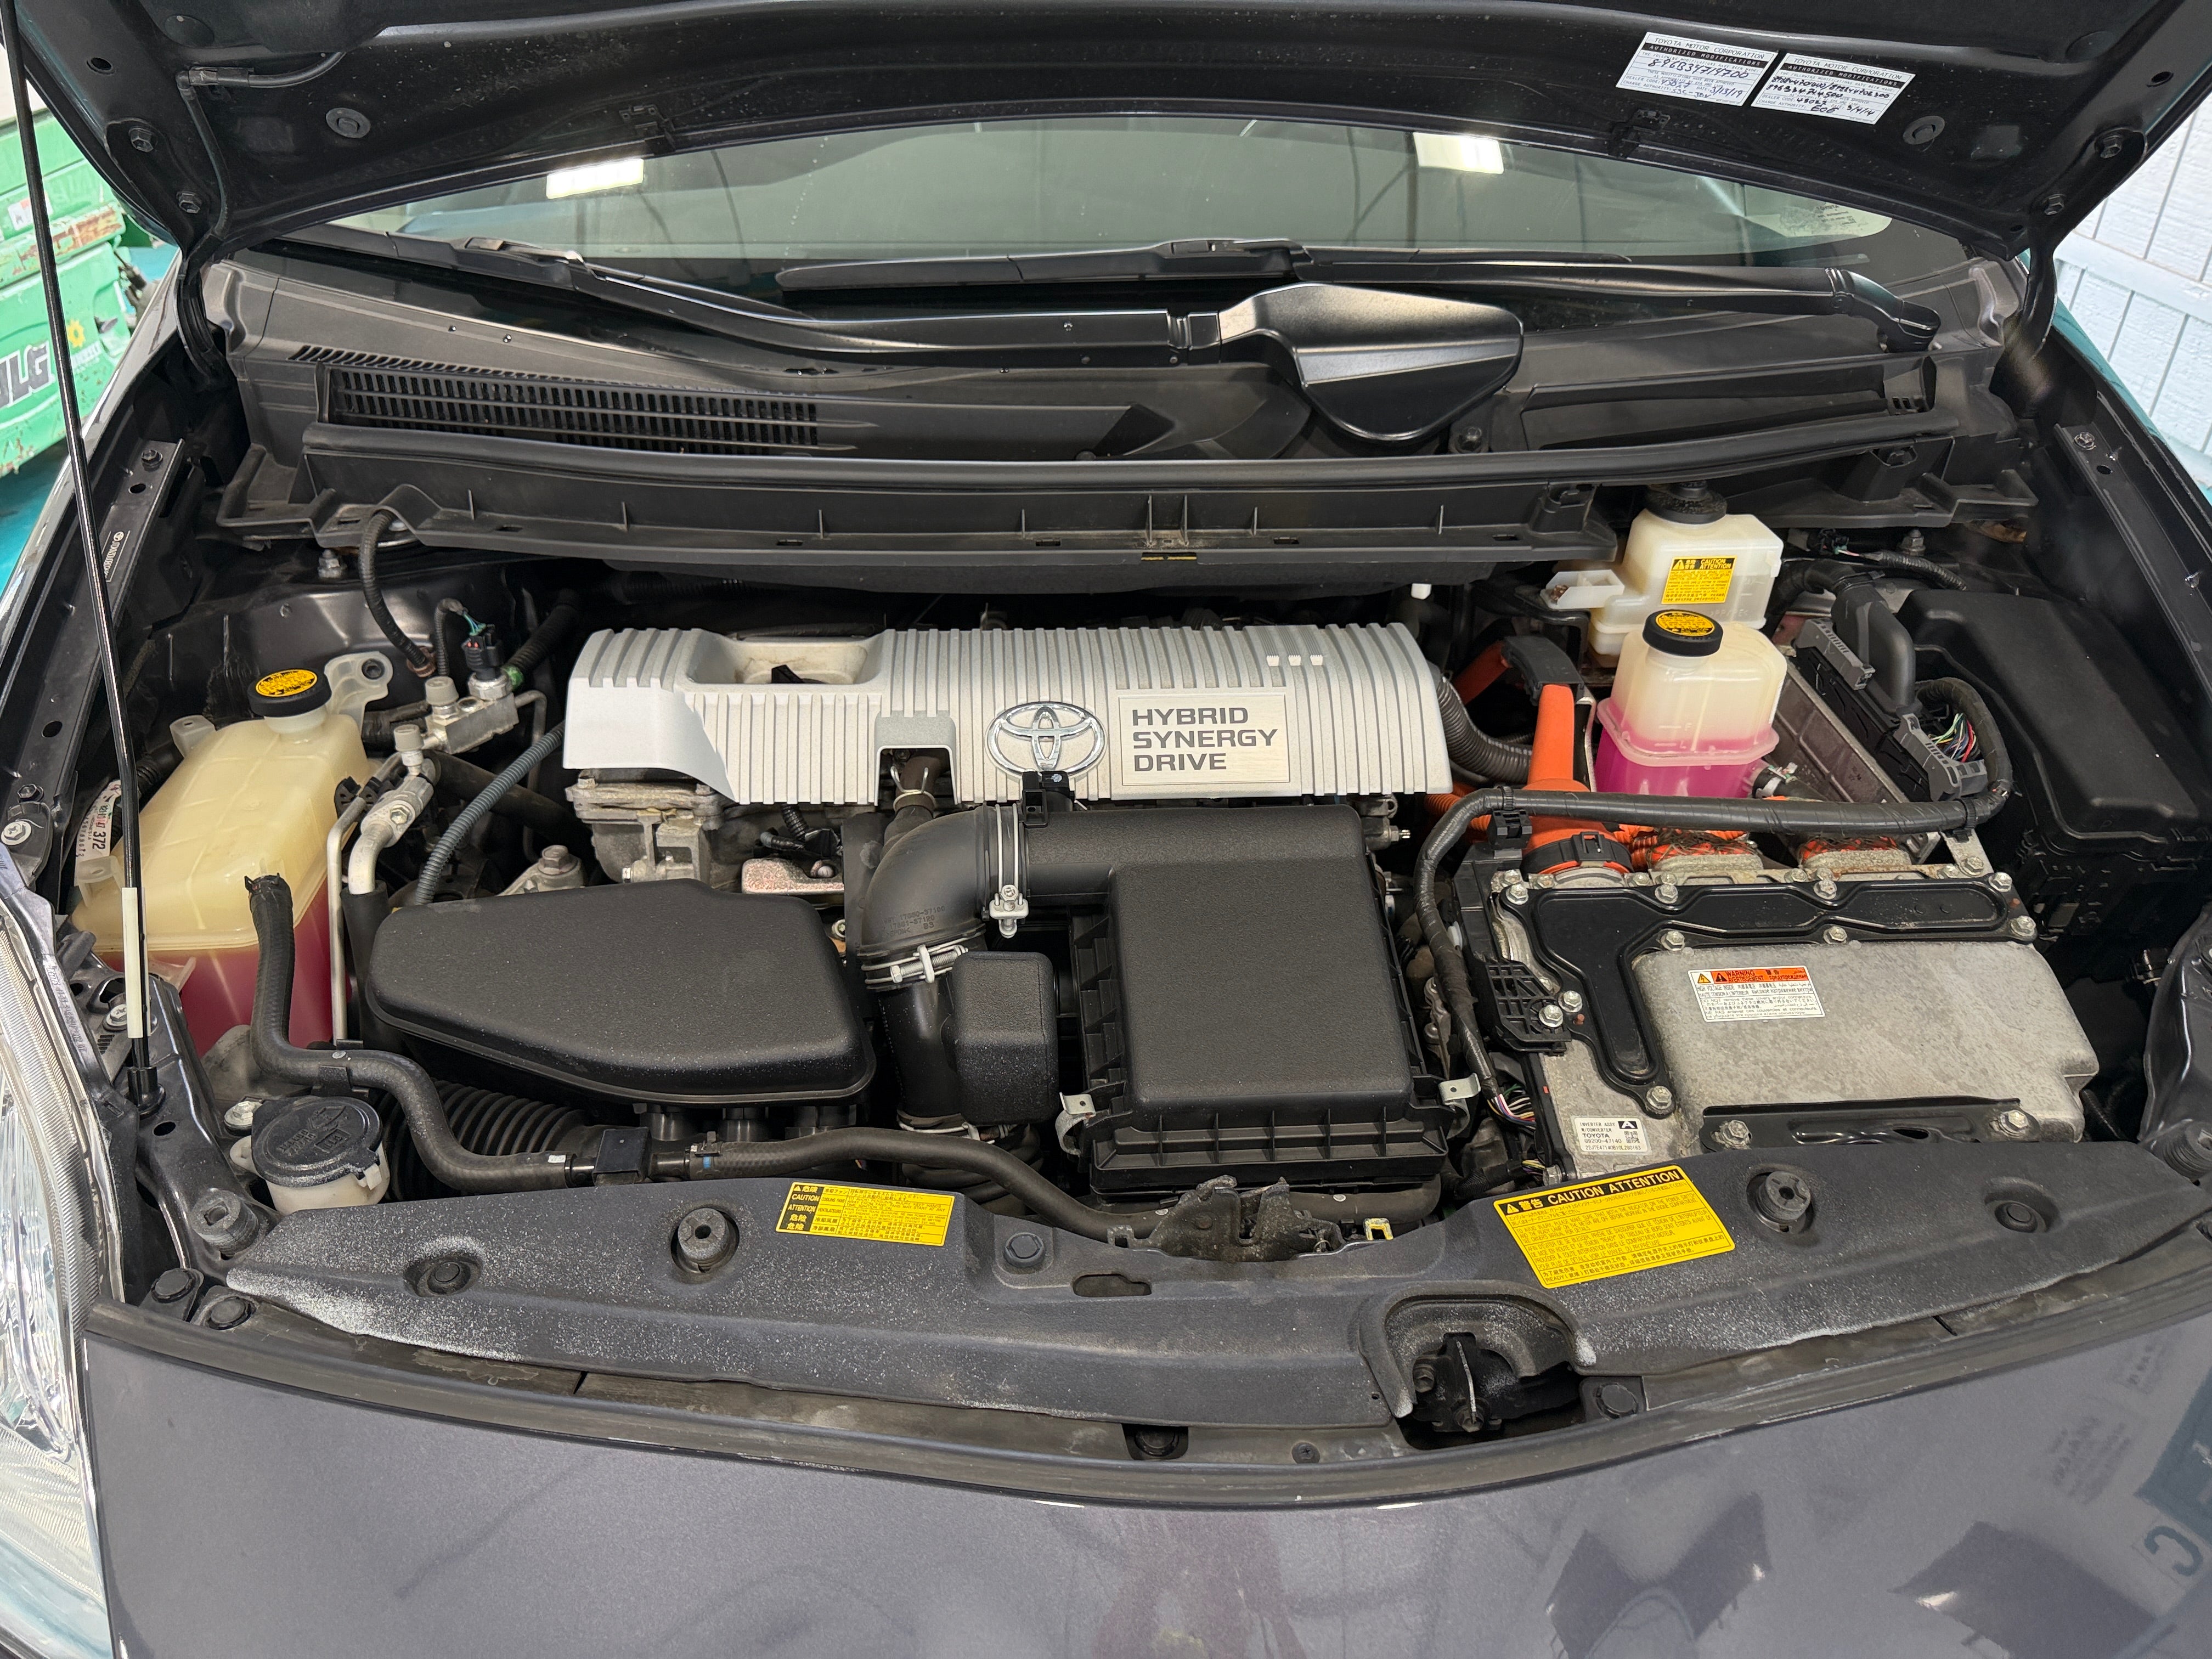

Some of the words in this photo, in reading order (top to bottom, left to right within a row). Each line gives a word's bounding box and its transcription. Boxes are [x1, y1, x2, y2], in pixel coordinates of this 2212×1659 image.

[1649, 44, 1697, 56] AUTHORIZED
[1700, 52, 1762, 66] MODIFICATIONS
[1653, 37, 1683, 46] TOYOTA
[1684, 42, 1710, 50] MOTOR
[1713, 46, 1765, 59] CORPORATION
[1679, 58, 1716, 66] MODIFICATIONS
[1792, 58, 1821, 66] TOYOTA
[1822, 63, 1848, 71] MOTOR
[1850, 67, 1903, 80] CORPORATION
[1786, 65, 1834, 76] AUTHORIZED
[1836, 72, 1899, 86] MODIFICATIONS
[1816, 77, 1853, 85] MODIFICATIONS
[1777, 101, 1807, 109] AUTHORITY:
[1133, 707, 1248, 726] HYBRID
[1133, 729, 1278, 749] SYNERGY
[1134, 753, 1227, 771] DRIVE
[92, 831, 106, 849] 372
[1547, 1186, 1605, 1205] CAUTION
[1609, 1170, 1680, 1193] ATTENTION
[791, 1193, 820, 1202] CAUTION
[1519, 1199, 1544, 1211] 警告
[1627, 1202, 1649, 1211] INDICATOR
[787, 1204, 816, 1212] ATTENTION
[1652, 1216, 1669, 1225] TÉMOIN
[1554, 1244, 1571, 1252] ROUTE
[1625, 1229, 1645, 1238] TABLEAU
[1537, 1262, 1551, 1271] POUR
[1550, 1260, 1564, 1268] PLUS
[1606, 1247, 1624, 1256] MANUEL
[1561, 1250, 1577, 1258] TOUTE
[1576, 1244, 1606, 1255] INTERVENTION
